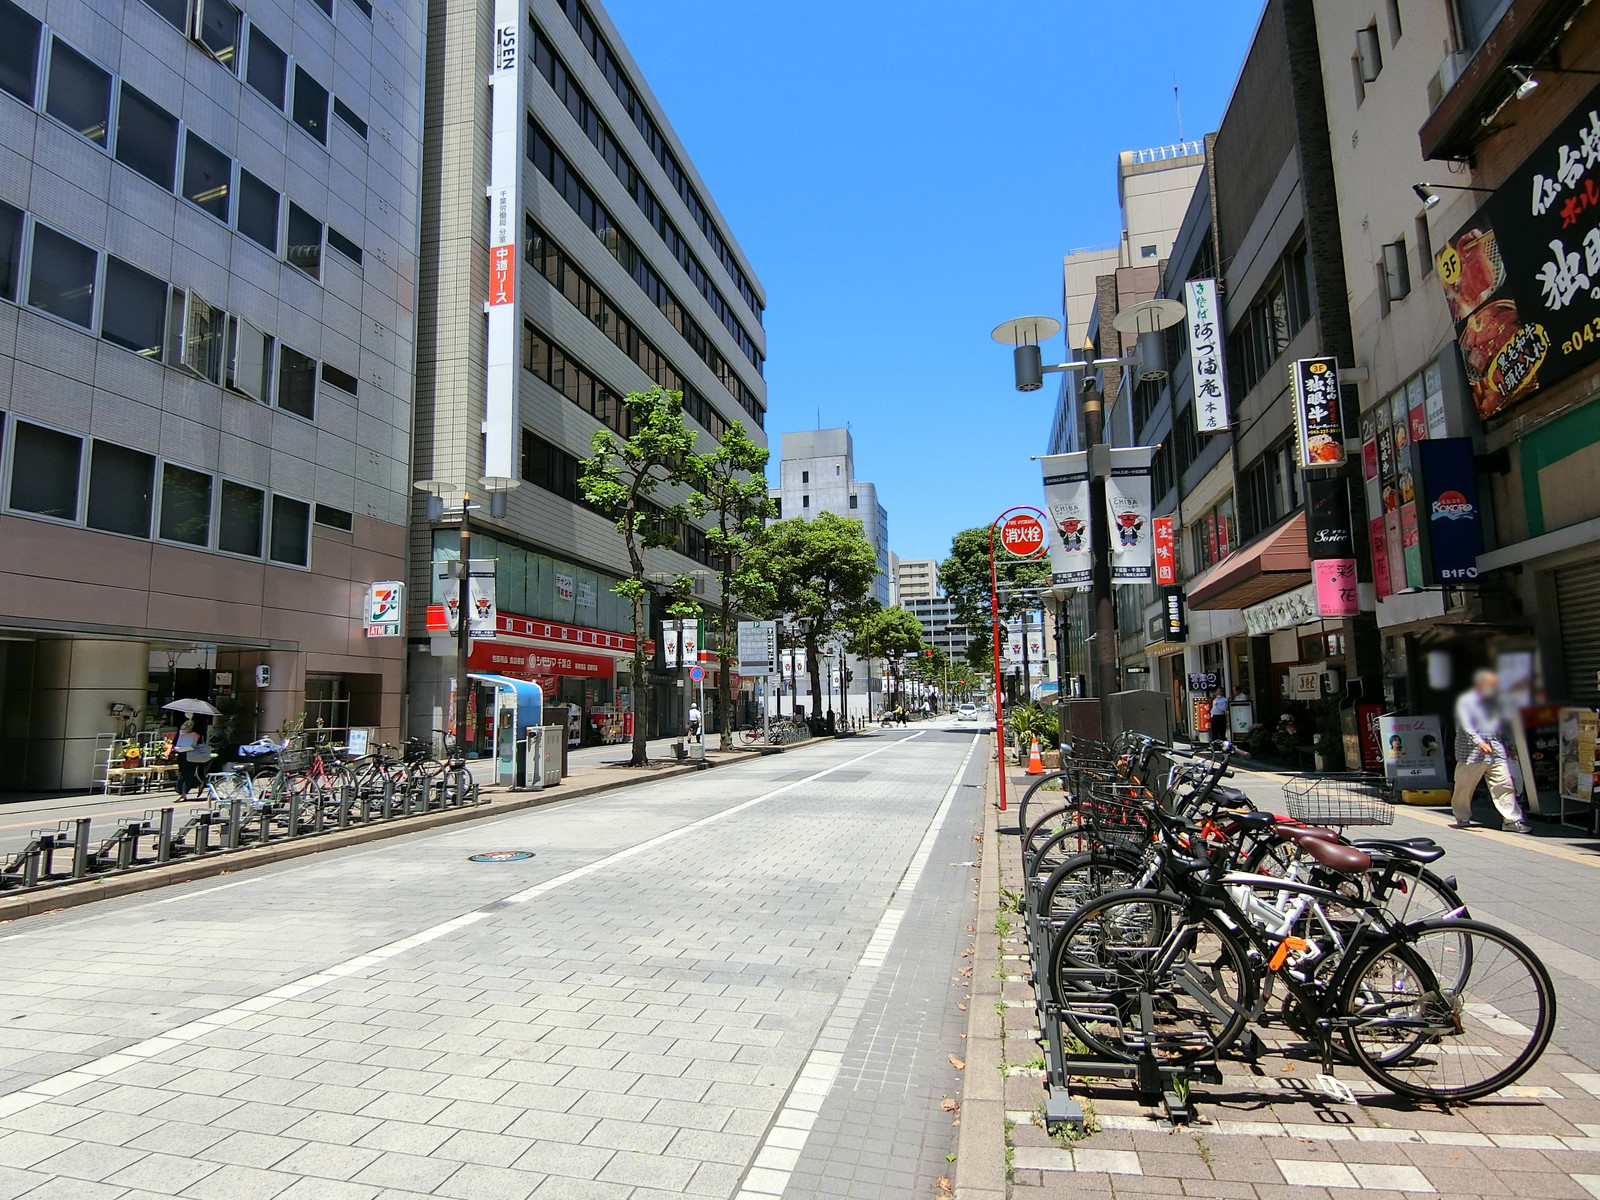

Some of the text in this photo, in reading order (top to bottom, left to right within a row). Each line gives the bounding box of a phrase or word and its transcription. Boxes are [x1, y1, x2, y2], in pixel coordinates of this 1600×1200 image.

[503, 25, 515, 70] USEN
[495, 247, 509, 304] 中道リース
[1442, 253, 1458, 280] 3F
[1497, 323, 1535, 375] 黒毛和牛
[1312, 365, 1324, 373] 3F
[1425, 369, 1440, 392] 6F
[1304, 374, 1329, 423] 独眼牛
[1408, 386, 1421, 403] 5F
[1204, 401, 1218, 428] 本店
[1363, 420, 1374, 439] 2F
[1114, 498, 1137, 506] CHIBA
[1432, 501, 1473, 512] KOKORO
[1005, 526, 1040, 544] 消火栓
[1157, 525, 1172, 579] 生味園
[1336, 563, 1356, 603] 彩花
[1441, 569, 1465, 578] B1F
[370, 625, 383, 635] ATM
